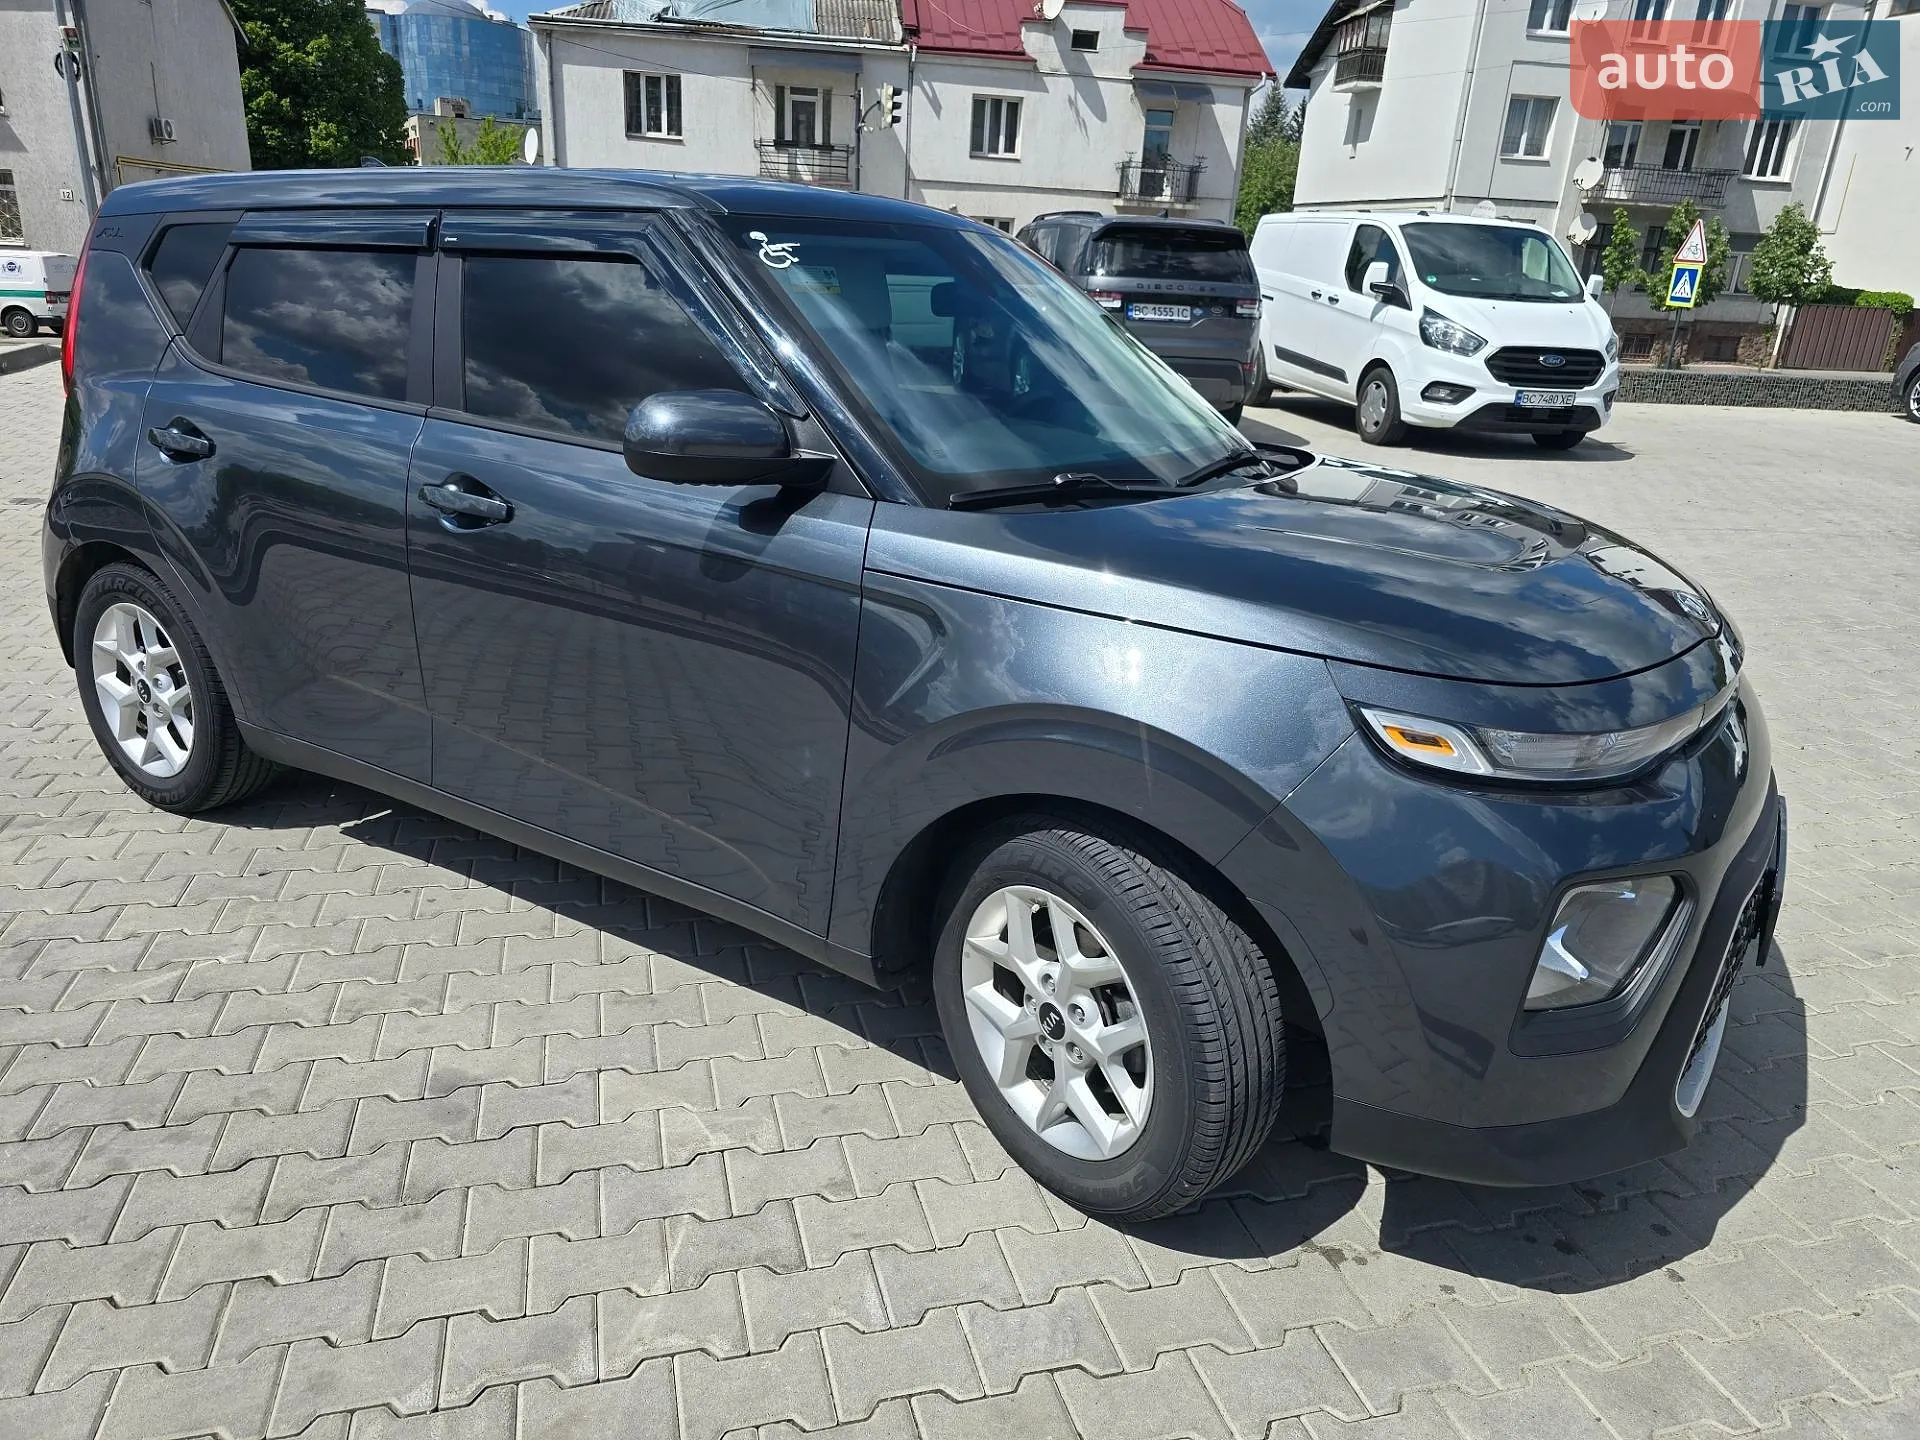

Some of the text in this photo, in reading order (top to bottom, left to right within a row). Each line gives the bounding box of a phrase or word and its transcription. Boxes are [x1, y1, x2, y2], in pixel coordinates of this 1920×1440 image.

[1136, 282, 1220, 292] DISCOER
[1134, 305, 1189, 318] BC 1555 IC
[1522, 394, 1573, 405] BC 7480 XE
[1043, 1011, 1060, 1034] KIA
